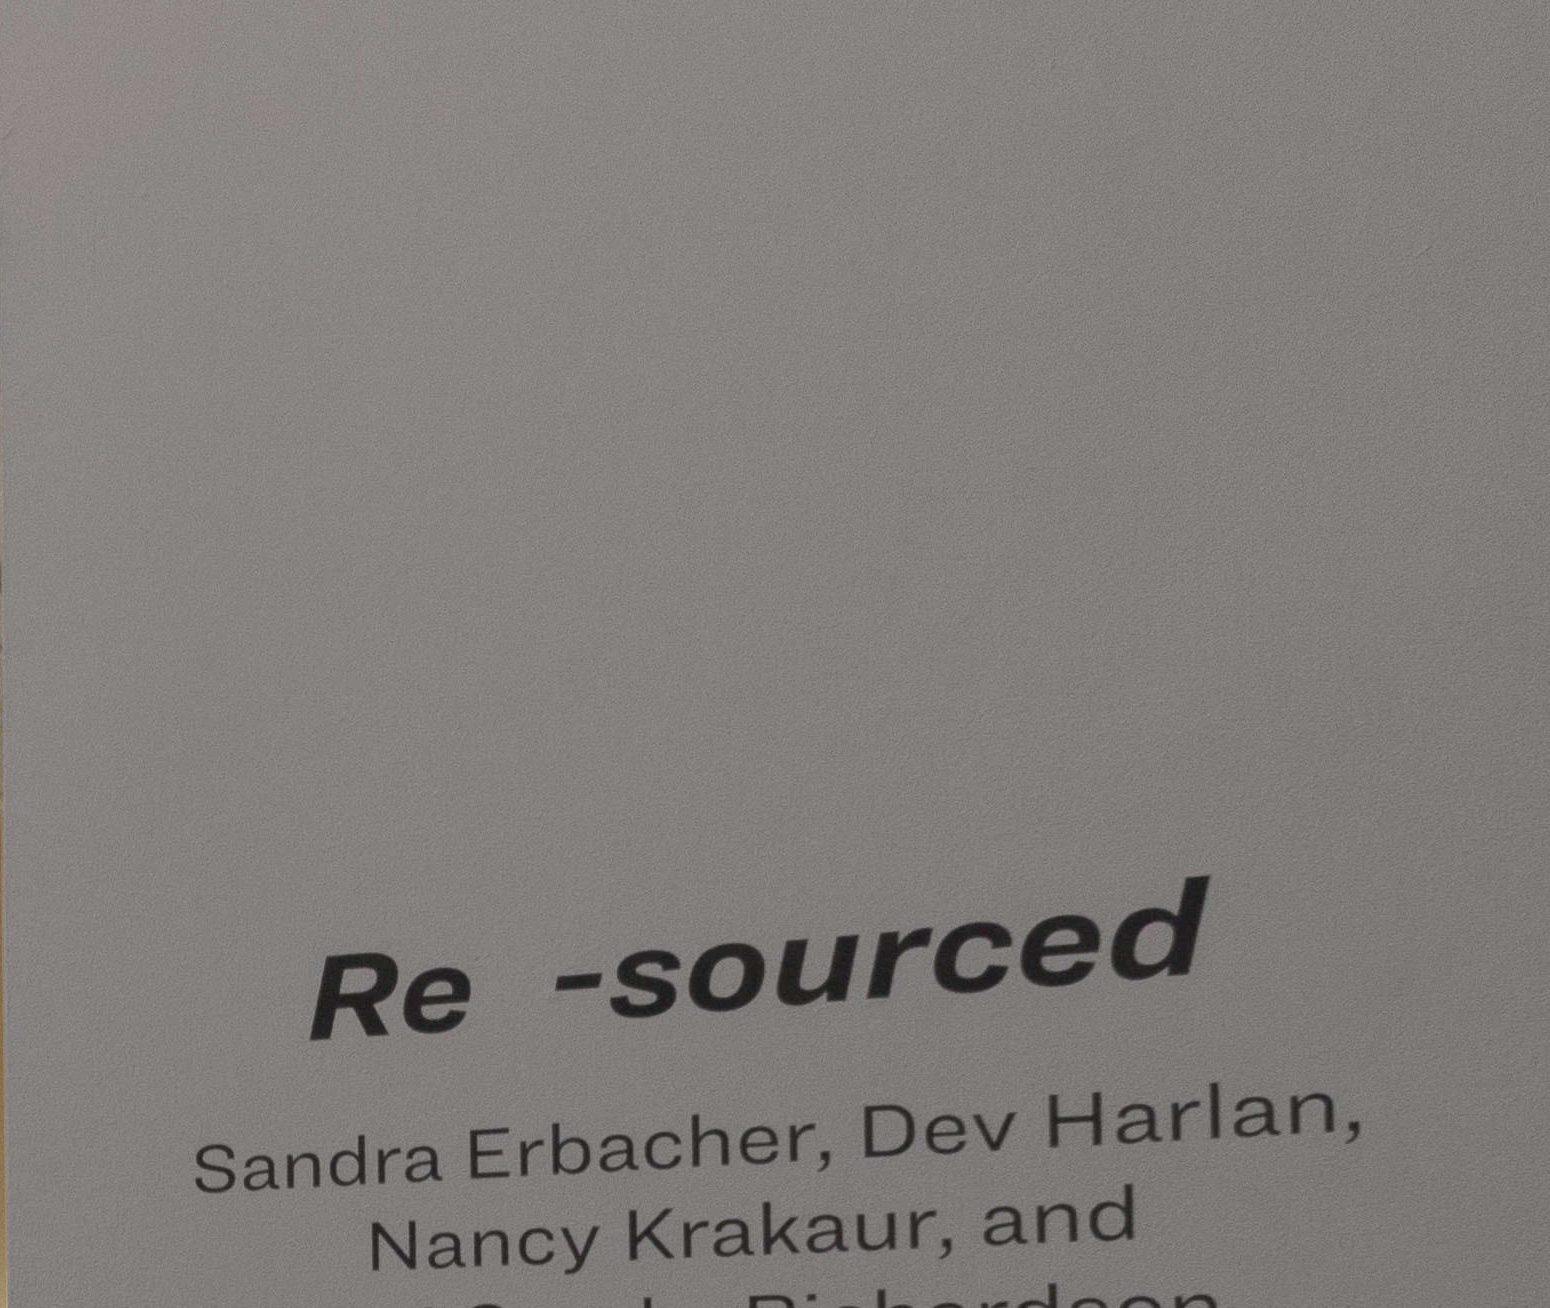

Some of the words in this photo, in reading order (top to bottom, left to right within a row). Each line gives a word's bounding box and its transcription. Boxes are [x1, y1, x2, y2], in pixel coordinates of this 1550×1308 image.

[308, 950, 474, 1043] Re
[553, 873, 1213, 1021] -sourced
[193, 1132, 444, 1196] Sandra
[467, 1112, 833, 1182] Erbacher,
[862, 1102, 1017, 1160] Dev
[1047, 1080, 1363, 1150] Harlan,
[369, 1218, 601, 1277] Nancy
[626, 1199, 954, 1263] Krakaur,
[981, 1181, 1137, 1248] and
